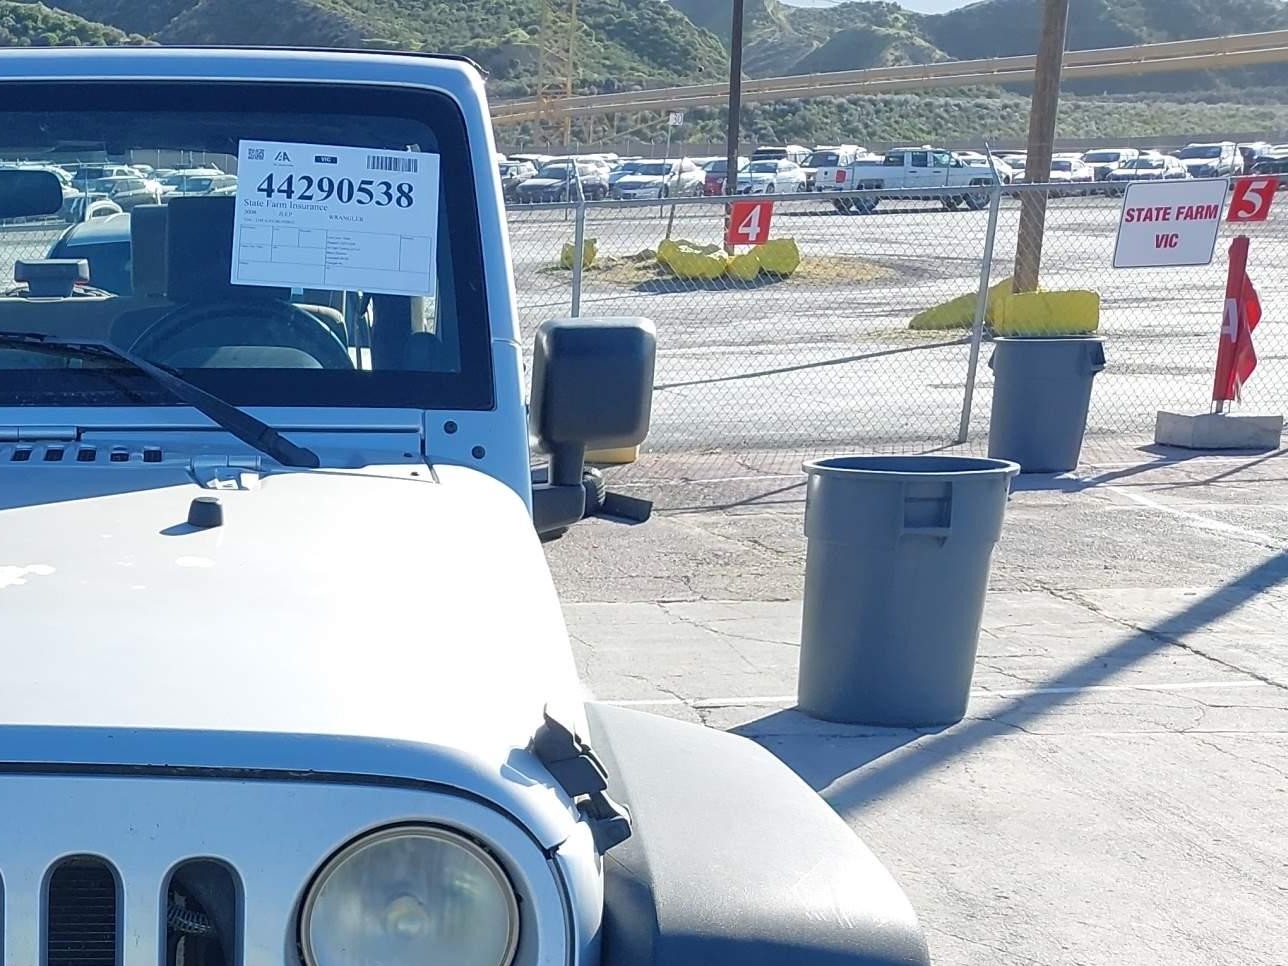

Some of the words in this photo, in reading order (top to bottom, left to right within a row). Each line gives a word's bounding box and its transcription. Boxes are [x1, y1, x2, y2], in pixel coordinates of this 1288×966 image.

[256, 172, 414, 208] 44290538
[1237, 181, 1268, 218] 5
[243, 199, 264, 208] State
[266, 200, 287, 209] Farm
[289, 201, 329, 212] Insurance
[1124, 206, 1172, 223] STATE
[1175, 204, 1219, 221] FARM
[328, 214, 364, 222] WRANGLER
[737, 204, 761, 241] 4
[1154, 233, 1179, 249] VIC
